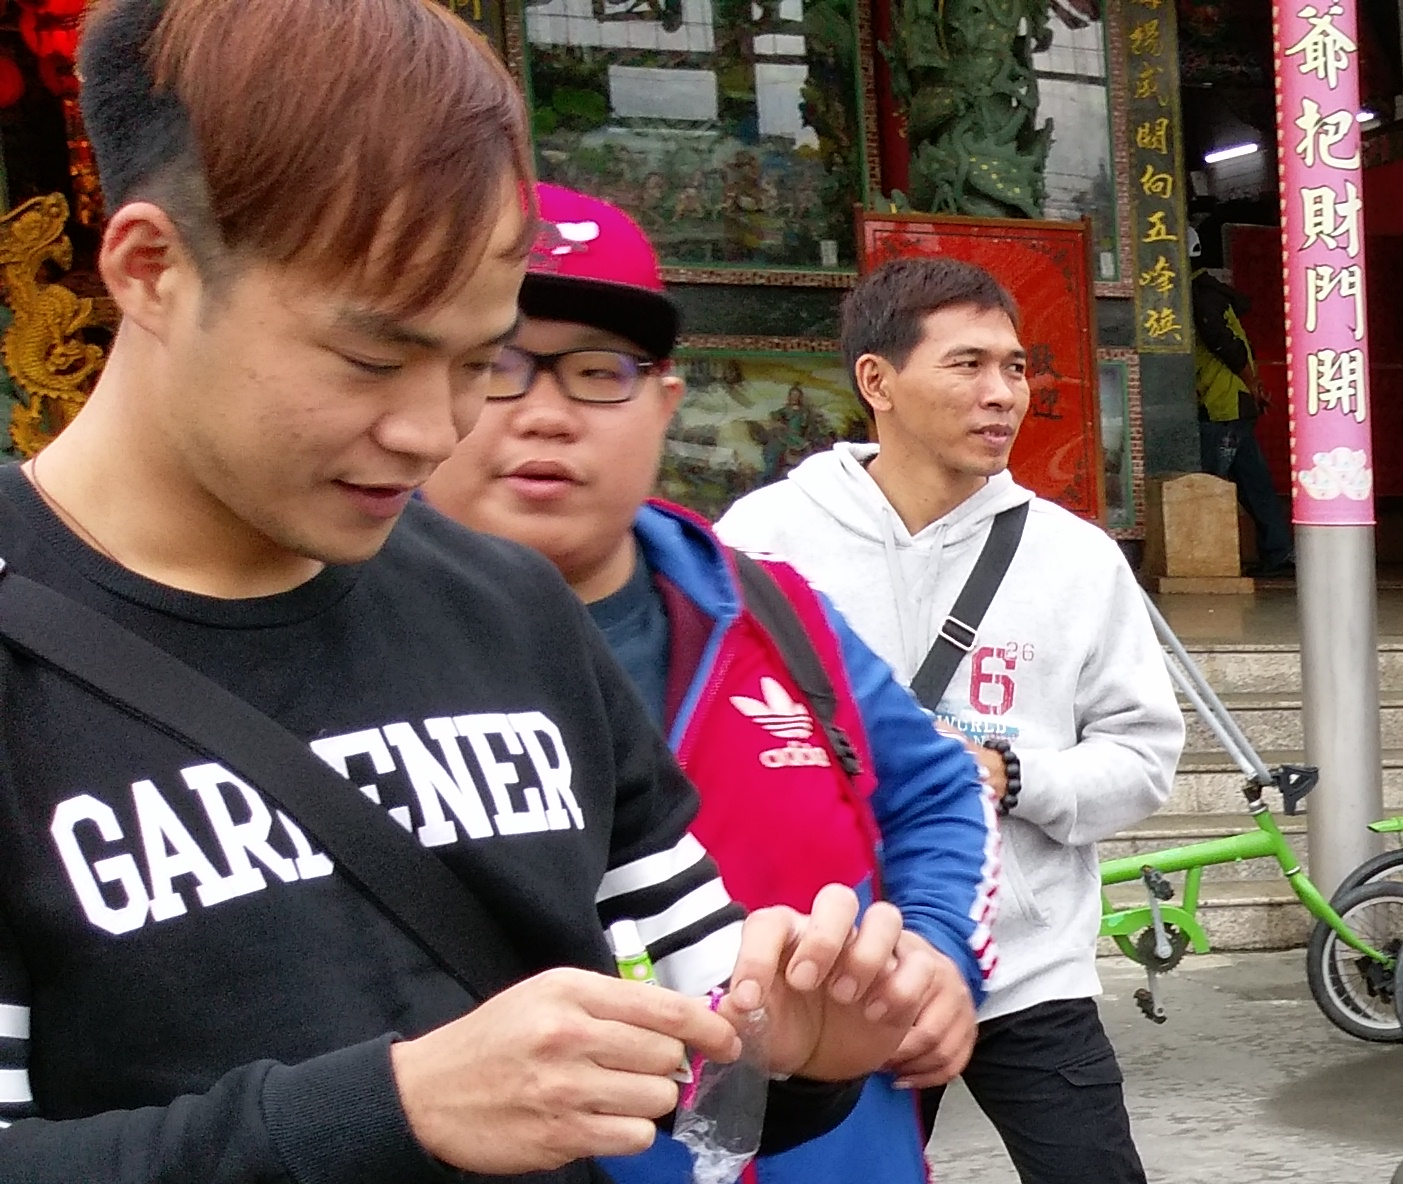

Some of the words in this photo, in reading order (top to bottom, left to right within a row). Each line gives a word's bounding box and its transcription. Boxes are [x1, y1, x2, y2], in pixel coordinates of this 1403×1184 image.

[1284, 0, 1367, 423] 爺把財門開
[969, 646, 1016, 716] 6
[50, 710, 586, 936] GARENER
